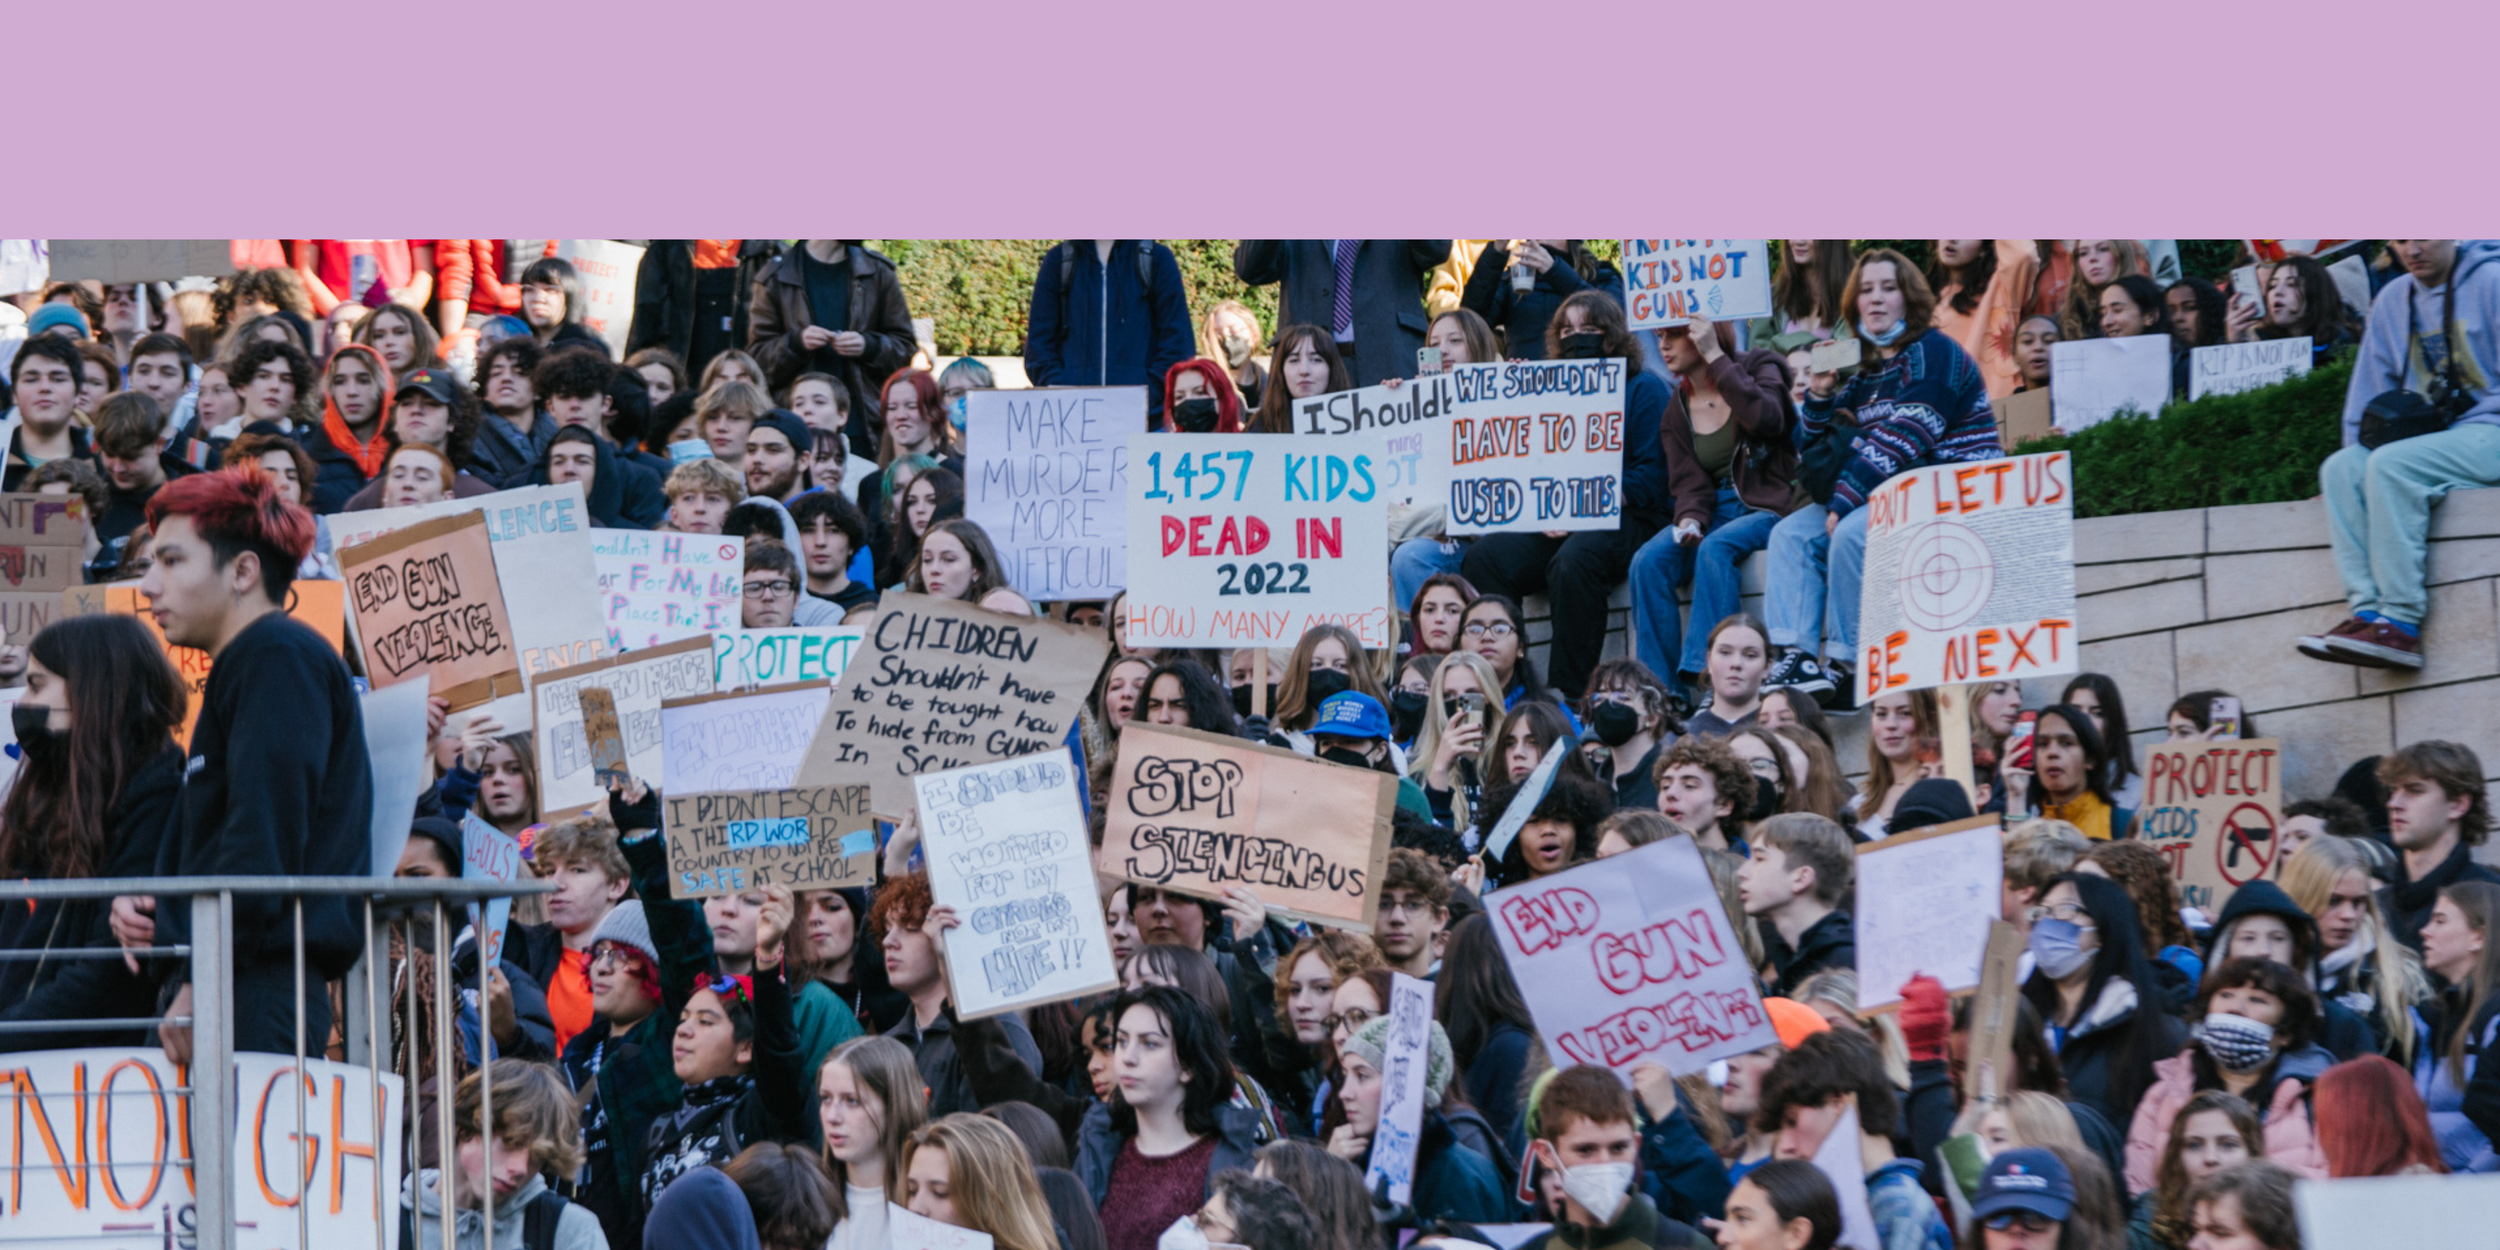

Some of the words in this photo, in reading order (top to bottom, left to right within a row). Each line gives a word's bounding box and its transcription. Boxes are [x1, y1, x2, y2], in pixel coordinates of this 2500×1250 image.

[1628, 259, 1683, 291] KIDS
[1689, 251, 1748, 281] NOT
[1633, 288, 1700, 320] GUNS
[1454, 367, 1497, 402] WE
[1504, 359, 1620, 399] SHOULDN'T
[2199, 346, 2235, 378] RIP
[2254, 342, 2284, 367] NOT
[1008, 398, 1104, 451] MAKE
[1452, 415, 1530, 465] HAVE
[1540, 413, 1576, 453] TO
[1585, 412, 1622, 452] BE
[982, 446, 1128, 503] MURDER
[1145, 450, 1254, 503] 1,457
[1285, 453, 1376, 502] KIDS
[1934, 461, 2016, 514] LET
[2024, 453, 2065, 507] US
[1012, 498, 1105, 542] MORE
[1451, 477, 1523, 527] USED
[662, 534, 713, 564] Have
[1161, 515, 1271, 558] DEAD
[1296, 516, 1342, 559] IN
[355, 564, 399, 612] END
[403, 552, 461, 611] GUN
[630, 563, 667, 591] For
[668, 567, 702, 600] My
[709, 572, 740, 597] Life
[998, 545, 1128, 592] DIFFICUL
[1217, 562, 1311, 596] 2022
[609, 593, 660, 622] Place
[663, 602, 700, 627] That
[703, 602, 731, 630] Is
[1129, 604, 1195, 638] HOW
[1209, 609, 1290, 641] MANY
[874, 611, 1039, 662] CHILDREN
[645, 653, 711, 699] PEACE
[717, 634, 861, 683] PROTECT
[871, 655, 990, 690] Shouldn't
[999, 672, 1055, 705] have
[1867, 630, 1910, 698] BE
[1944, 619, 2073, 682] NEXT
[835, 710, 856, 731] To
[867, 715, 915, 741] hide
[922, 719, 975, 746] from
[852, 684, 874, 702] to
[886, 690, 914, 711] be
[1015, 710, 1059, 734] how
[835, 743, 869, 764] In
[922, 778, 954, 810] I
[1128, 755, 1243, 818] STOP
[2149, 748, 2276, 805] PROTECT
[670, 799, 687, 827] I
[697, 791, 770, 822] DIDN'T
[779, 785, 870, 820] ESCAPE
[937, 807, 984, 842] BE
[2141, 806, 2200, 840] KIDS
[671, 835, 686, 858] A
[691, 821, 759, 852] THIRD
[764, 817, 837, 845] WORLD
[674, 847, 756, 873] COUNTRY
[760, 844, 781, 860] TO
[787, 841, 812, 855] NOT
[818, 838, 841, 854] BE
[681, 867, 745, 894] SAFE
[753, 865, 773, 887] AT
[781, 856, 857, 884] SCHOOL
[1024, 863, 1058, 894] MY
[1000, 923, 1042, 944] NOT
[1046, 916, 1079, 936] MY
[1501, 887, 1600, 956] END
[1591, 909, 1727, 995] GUN
